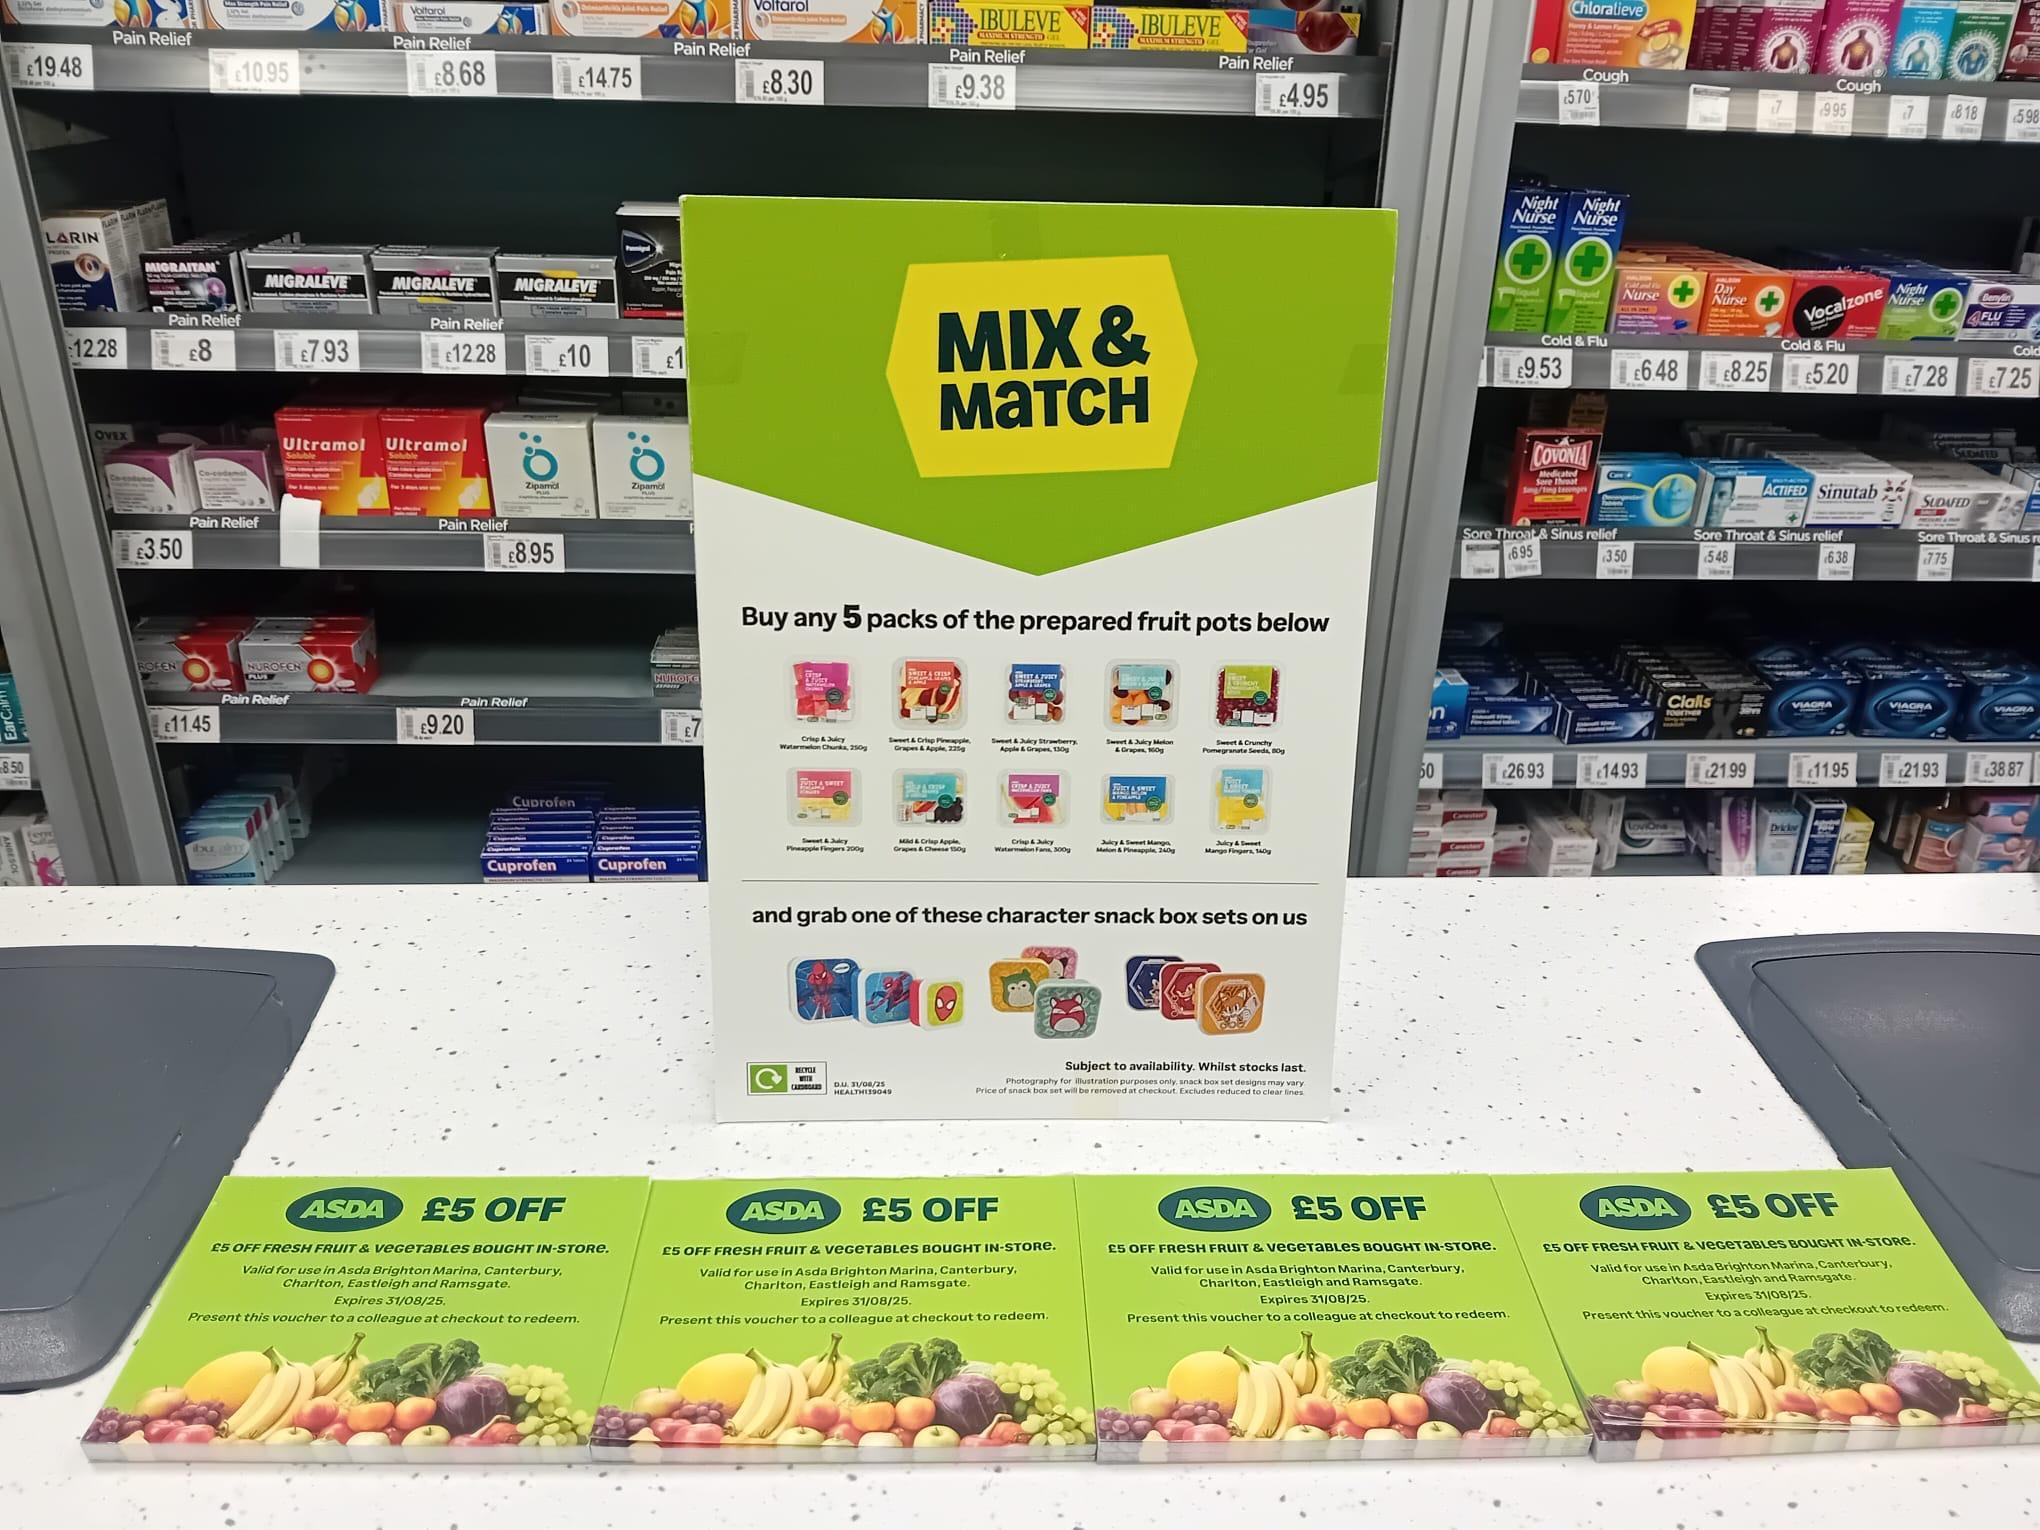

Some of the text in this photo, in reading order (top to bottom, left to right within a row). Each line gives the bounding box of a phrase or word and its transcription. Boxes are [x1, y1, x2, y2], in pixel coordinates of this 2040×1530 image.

[410, 5, 446, 16] Voltarol
[1572, 0, 1643, 17] Chloralieve
[1141, 13, 1221, 38] IBULEVE
[673, 42, 751, 57] Pain Relief
[27, 55, 82, 78] £19.48
[435, 60, 485, 87] £8.68
[579, 67, 632, 89] £14.75
[763, 69, 812, 96] £8.30
[1582, 68, 1630, 85] Cough
[955, 74, 1005, 101] £9.38
[1280, 83, 1328, 109] £4.95
[1521, 195, 1560, 214] Night
[1512, 209, 1557, 225] Nurse
[145, 262, 217, 274] MIGRAITAN
[265, 274, 349, 290] MIGRALEVE
[514, 278, 598, 294] MIGRALEVE
[1804, 288, 1884, 324] Vocalzone
[168, 313, 242, 328] Pain Relief
[938, 304, 1151, 373] MIX &
[1541, 334, 1608, 348] Cold & Flu
[189, 338, 213, 363] £8
[301, 339, 349, 363] £7.93
[560, 344, 591, 368] £10
[1517, 356, 1562, 380] £9.53
[1634, 359, 1678, 382] £6.48
[1724, 360, 1767, 383] £8.25
[1805, 362, 1849, 386] £5.20
[1905, 365, 1948, 388] £7.28
[1988, 366, 2032, 389] £7.25
[283, 437, 365, 452] Ultramol
[386, 437, 467, 452] Ultramol
[1533, 444, 1589, 468] COVONIA
[1763, 484, 1808, 498] ACTIFED
[1817, 483, 1878, 501] Sinutab
[1923, 494, 1971, 509] SUDAFED
[1694, 530, 1843, 542] Sore Throat & Sinus relief
[136, 538, 183, 561] £3.50
[508, 542, 555, 565] £8.95
[742, 604, 1330, 636] Buy any 5 packs of the prepared fruit pots below
[248, 662, 301, 673] NUROFEN
[1791, 700, 1833, 710] VIAGRA
[164, 715, 211, 733] £11.45
[421, 714, 464, 735] £9.20
[1202, 747, 1247, 755] Pomegranate
[1244, 739, 1272, 747] Crunchy
[1502, 762, 1545, 780] £26.93
[1596, 762, 1639, 780] £14.93
[1704, 762, 1746, 779] £21.99
[1807, 761, 1849, 779] £11.95
[487, 858, 557, 875] Cuprofen
[752, 906, 1307, 927] and grab one of these character snack box sets on us
[1065, 1060, 1306, 1073] Subject to availability. Whilst stocks last.
[1005, 1077, 1058, 1086] Photography
[1060, 1077, 1072, 1085] for
[1075, 1077, 1119, 1085] illustration
[1159, 1078, 1177, 1086] only,
[1234, 1079, 1266, 1087] designs
[299, 1196, 567, 1222] ASDA £5 OFF
[740, 1197, 998, 1222] ASDA £5 OFF
[1174, 1195, 1426, 1221] ASDA £5 OFF
[1598, 1192, 1839, 1219] ASDA £5 OFF
[210, 1242, 231, 1252] £5
[232, 1243, 262, 1253] OFF
[358, 1243, 369, 1253] &
[243, 1265, 562, 1277] Valid for use in Asda Brighton Marina, Canterbury,
[282, 1278, 510, 1290] Charlton, Eastleigh and Ramsgate.
[333, 1295, 446, 1307] Expires 31/08/25.
[187, 1312, 580, 1325] Present this voucher to a colleague at checkout to redeem.
